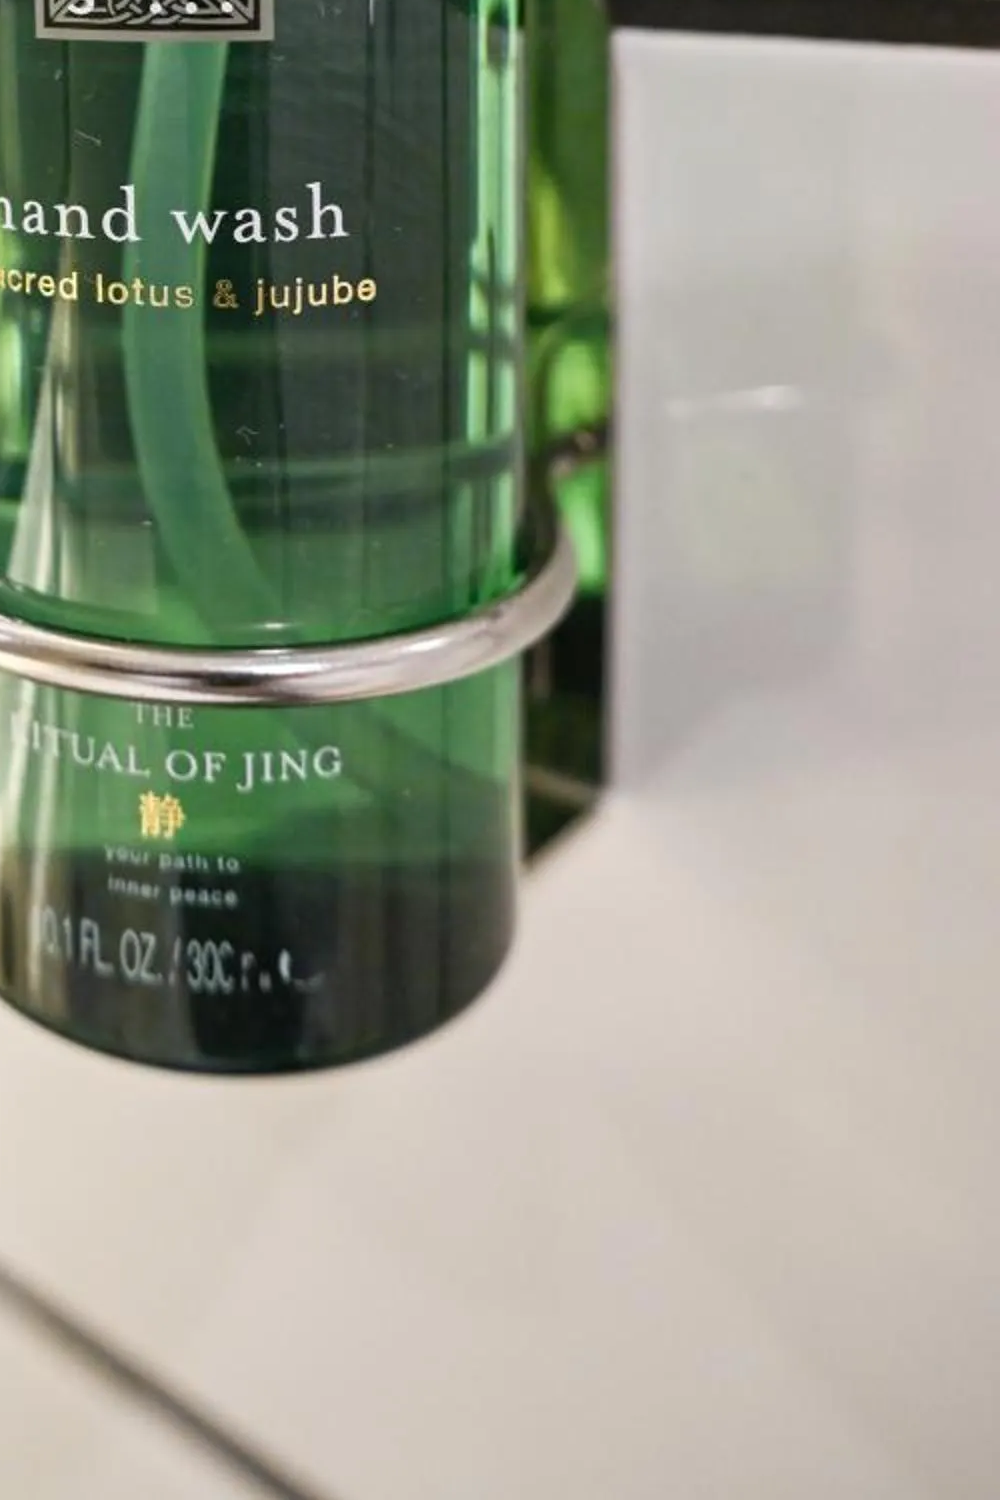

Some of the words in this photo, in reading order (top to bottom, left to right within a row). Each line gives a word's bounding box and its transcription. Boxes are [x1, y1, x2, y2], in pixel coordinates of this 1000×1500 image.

[169, 181, 351, 245] wash
[95, 273, 195, 308] lotus
[212, 278, 239, 310] &
[255, 274, 378, 317] jujube
[132, 703, 194, 729] THE
[165, 749, 228, 784] OF
[236, 745, 344, 793] JING
[159, 851, 210, 873] path
[217, 855, 241, 875] to
[107, 874, 160, 900] inner
[169, 886, 239, 909] peace
